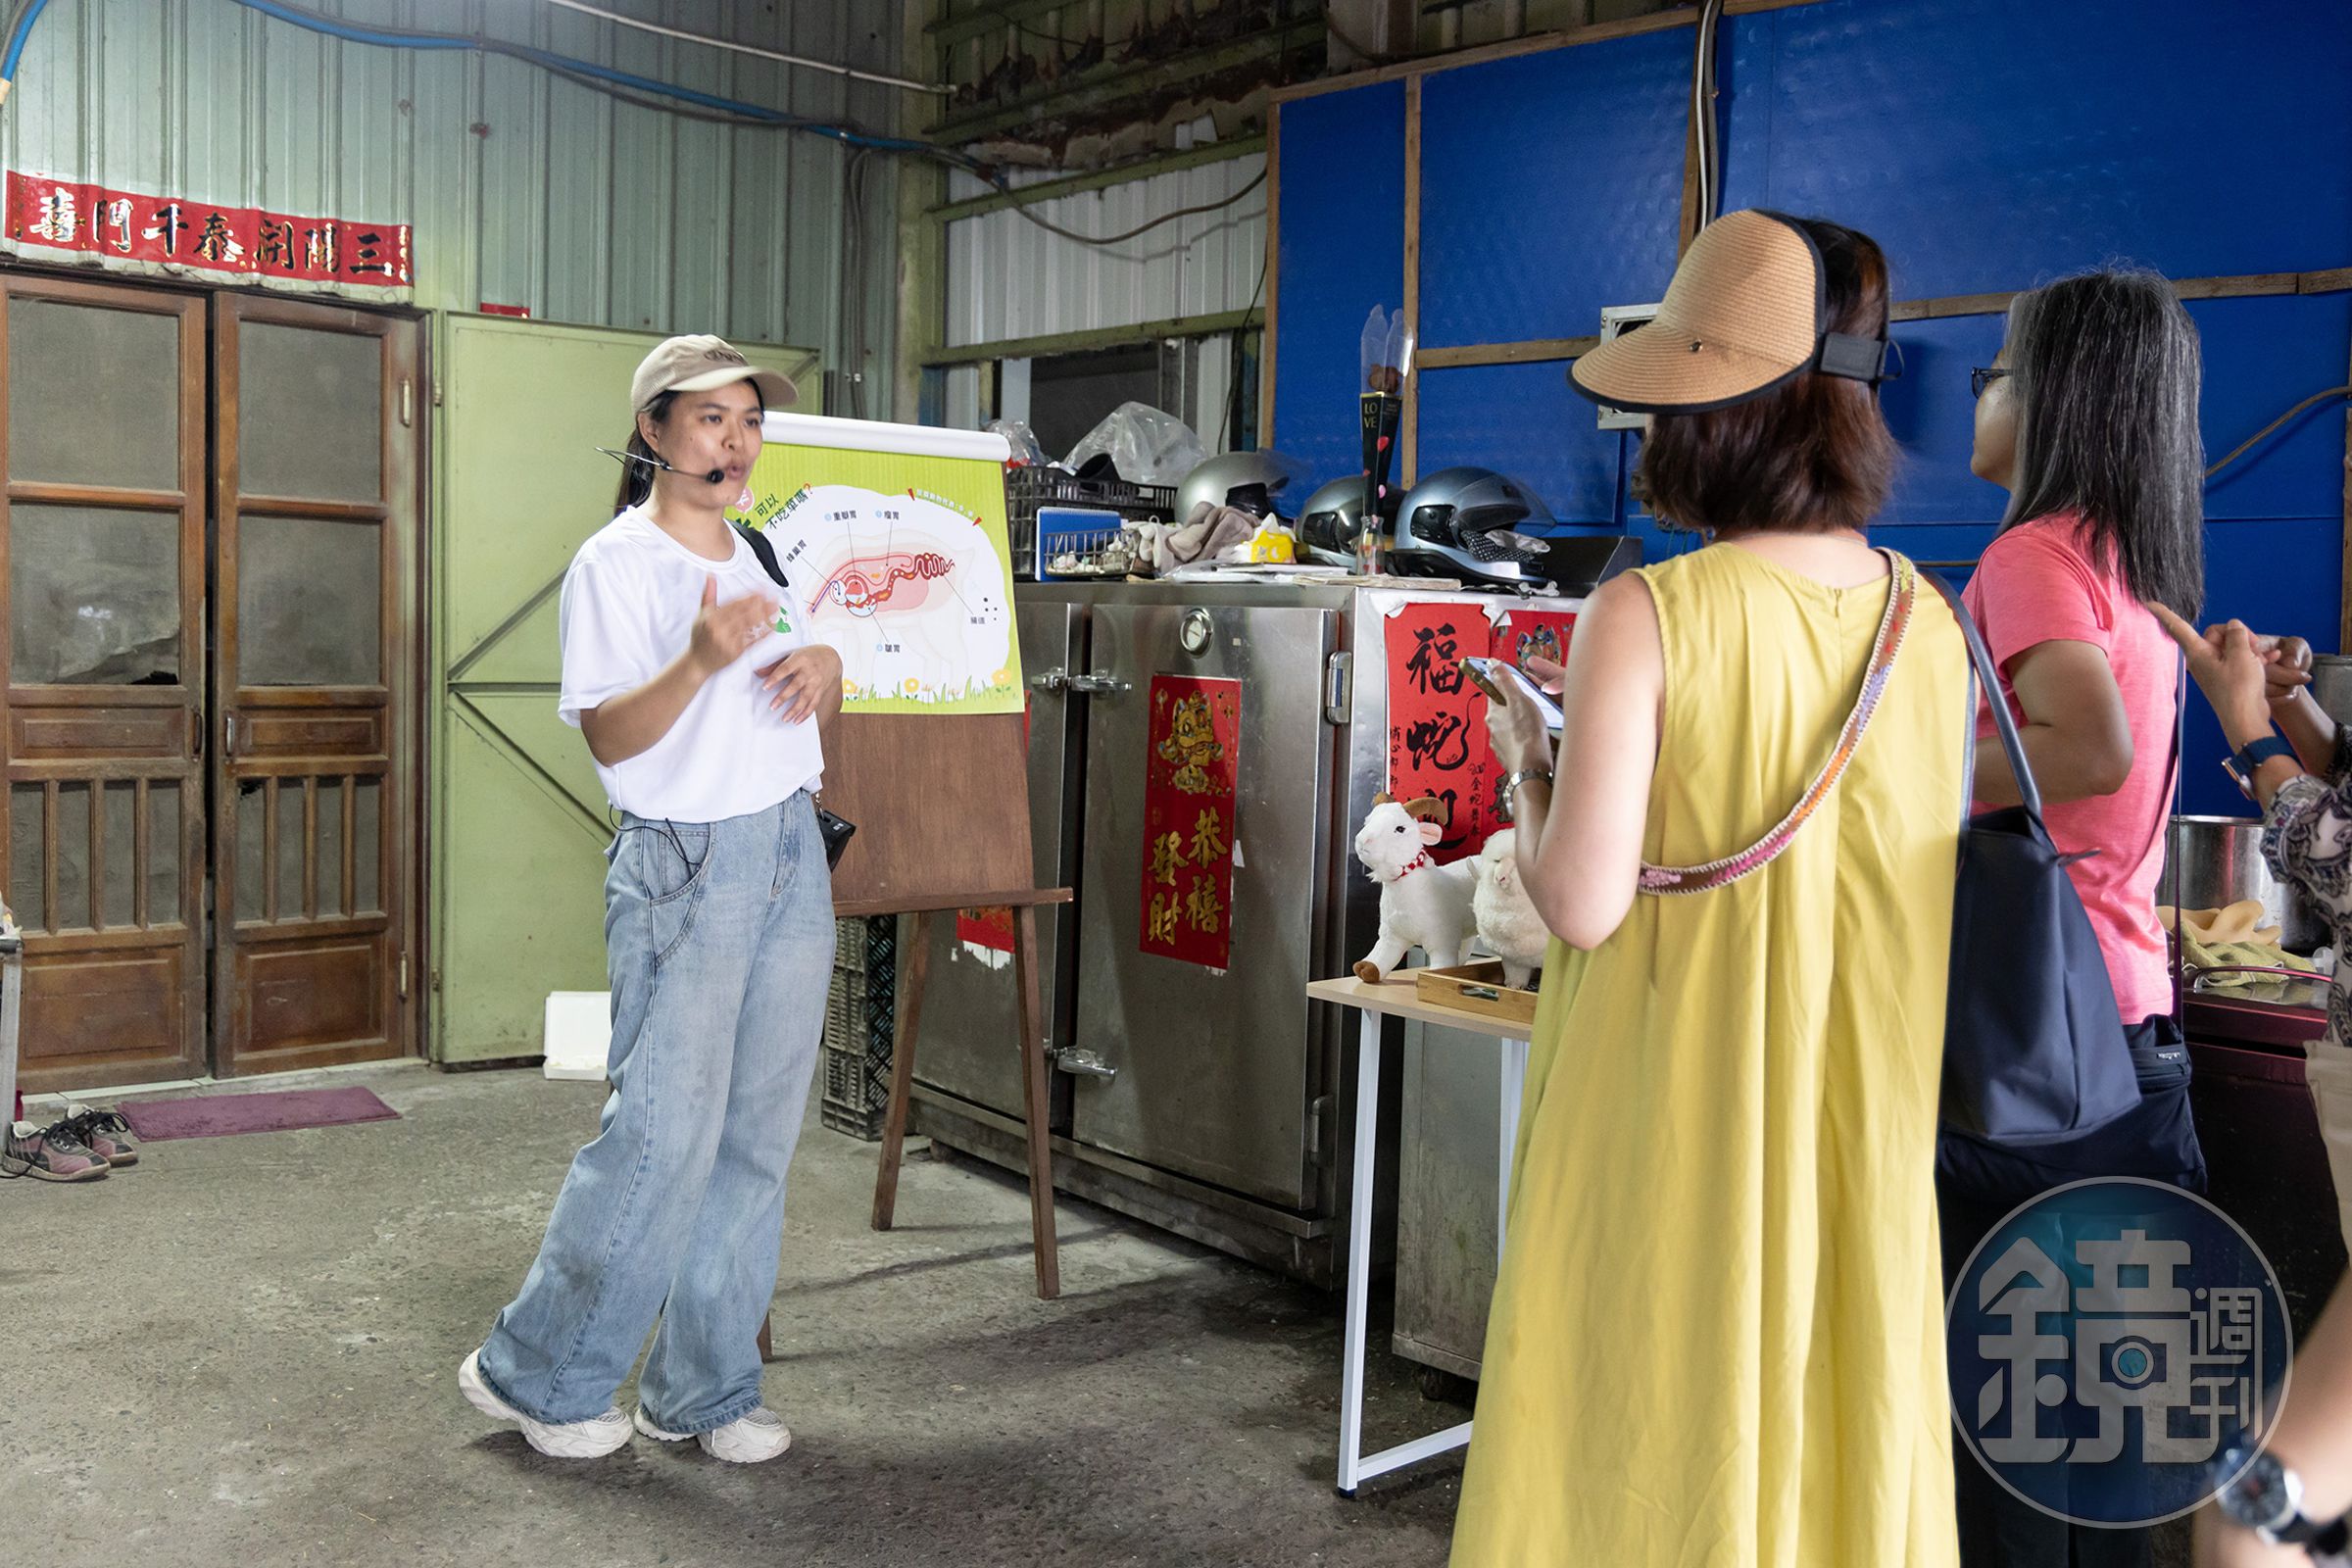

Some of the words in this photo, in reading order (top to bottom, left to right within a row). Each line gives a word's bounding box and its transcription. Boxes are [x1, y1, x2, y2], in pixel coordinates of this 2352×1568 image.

[1364, 402, 1378, 415] LO
[1364, 416, 1377, 428] VE
[755, 493, 779, 516] 可以
